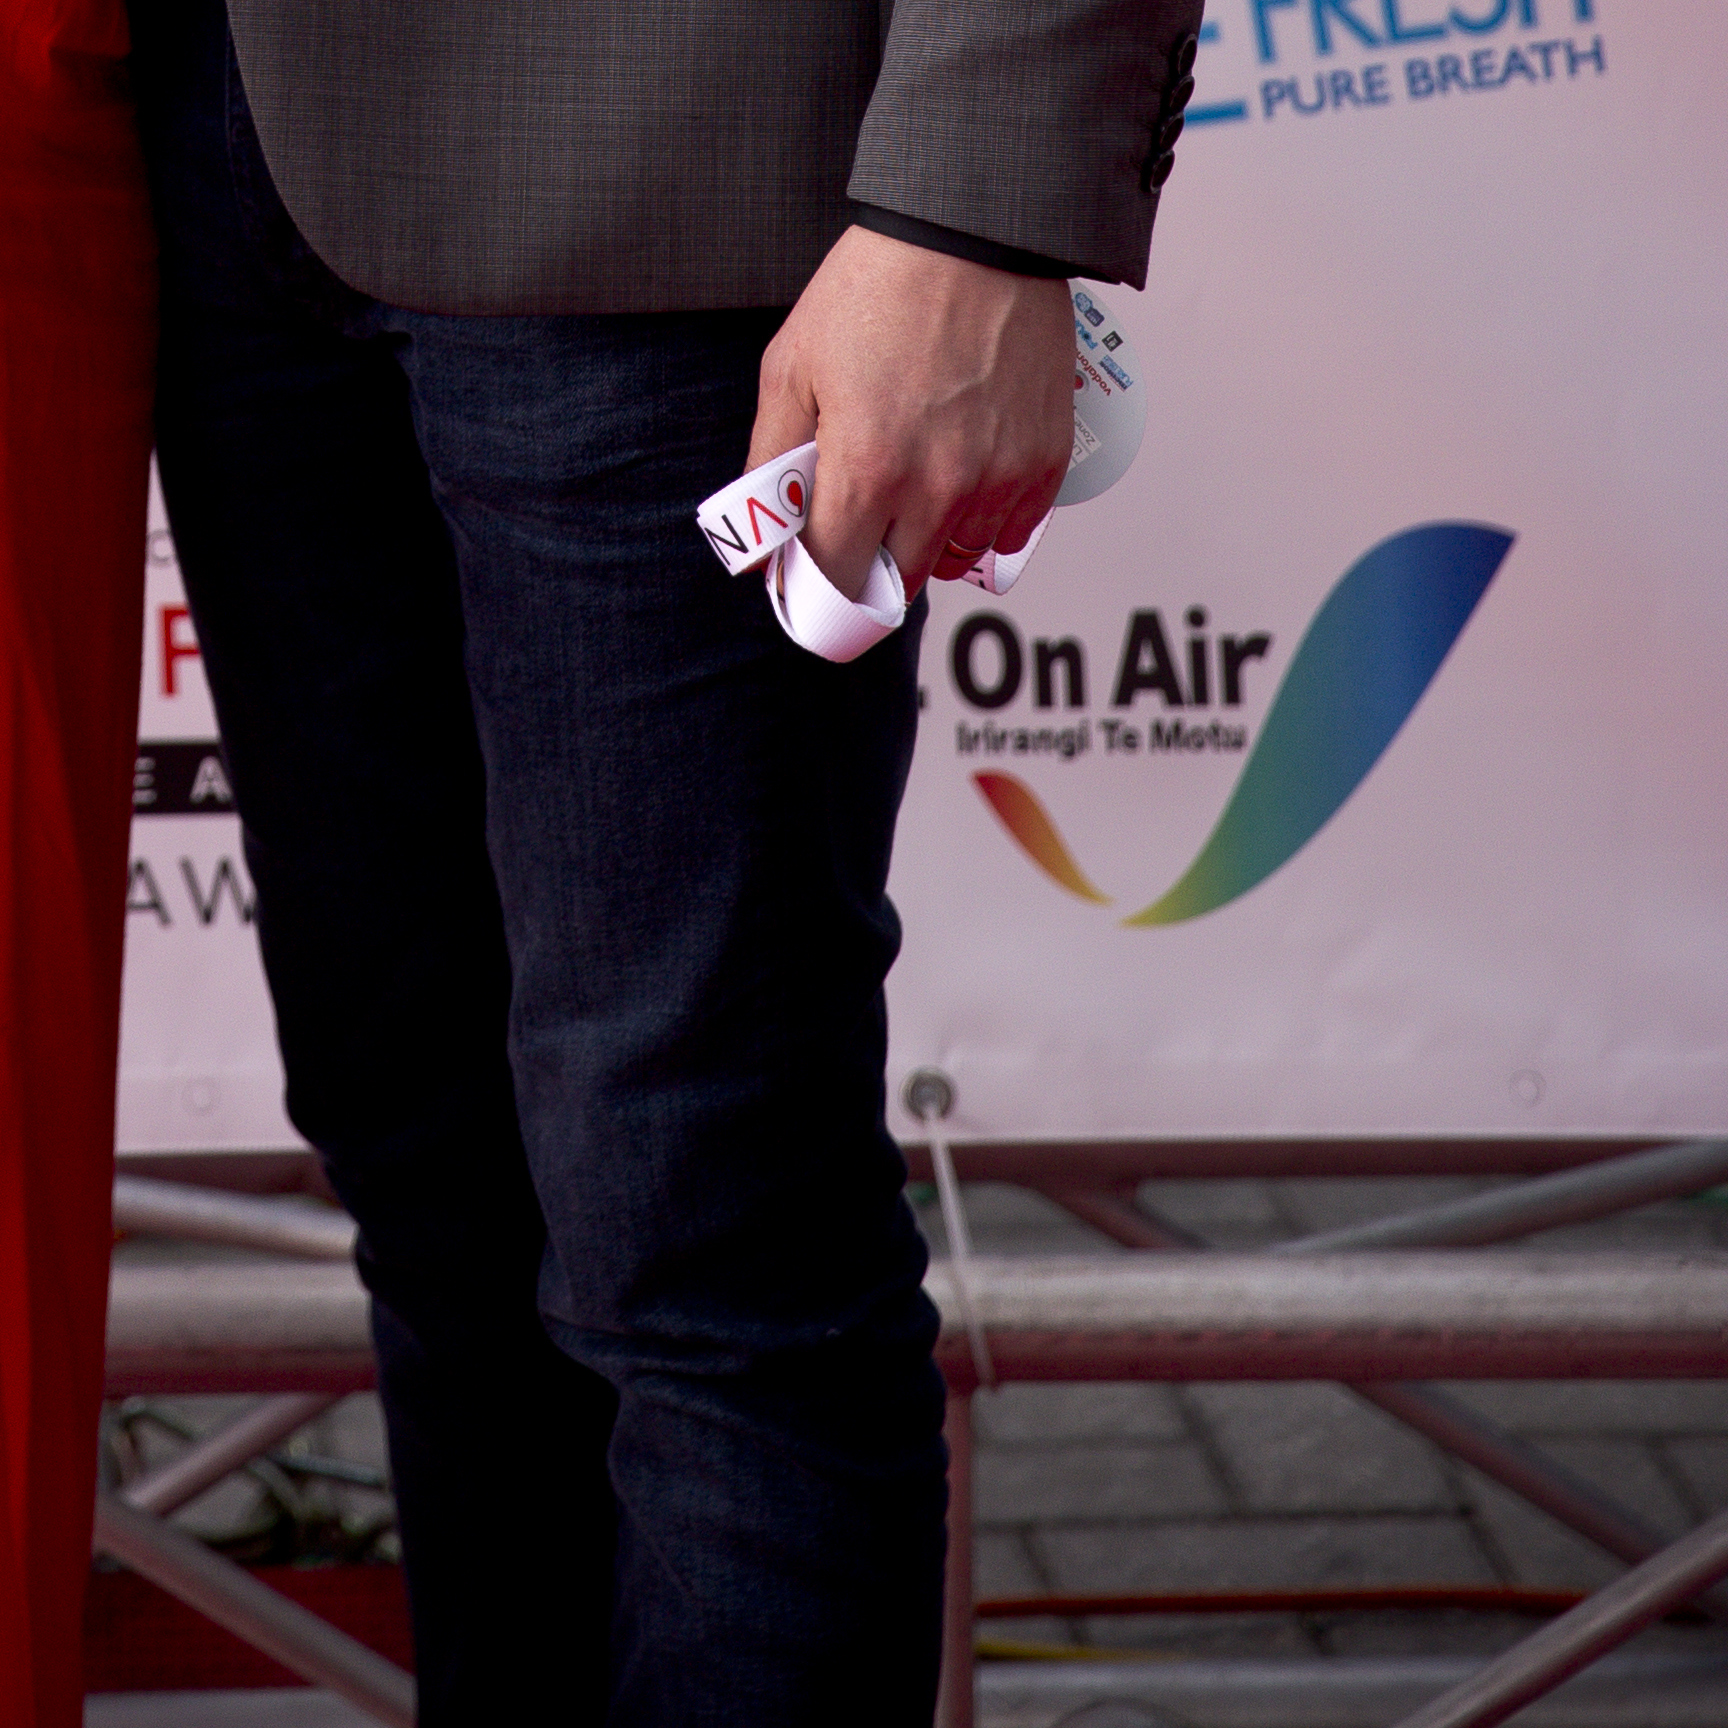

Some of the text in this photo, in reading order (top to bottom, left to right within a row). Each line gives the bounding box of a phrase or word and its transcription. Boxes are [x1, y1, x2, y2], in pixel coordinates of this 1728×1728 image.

[1259, 33, 1606, 120] PURE BREATH
[947, 605, 1274, 713] On Air
[956, 718, 1246, 762] Irirangi Te Motu
